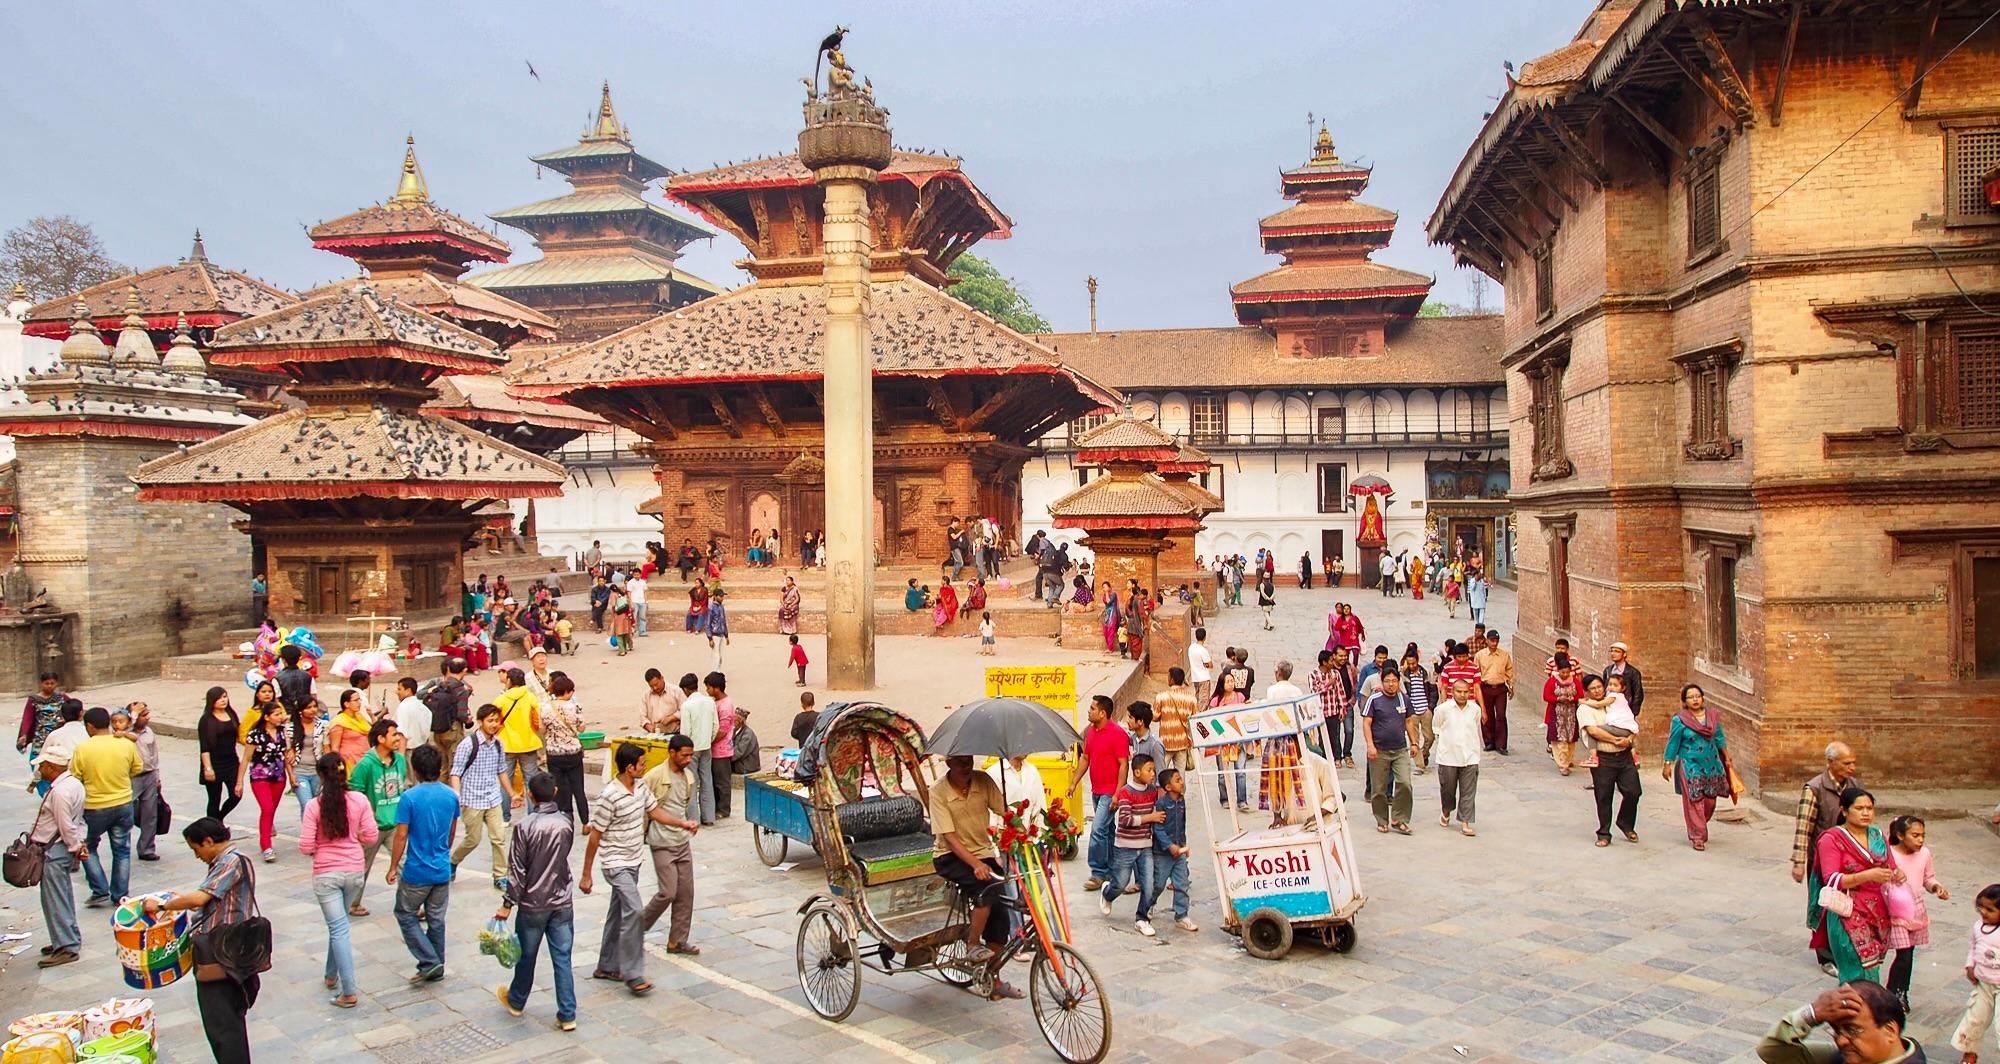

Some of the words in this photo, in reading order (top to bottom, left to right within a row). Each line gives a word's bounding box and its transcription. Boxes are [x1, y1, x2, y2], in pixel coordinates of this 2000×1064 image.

[989, 671, 1028, 686] स्पेशल
[1030, 667, 1067, 688] कुल्फी
[1243, 849, 1311, 877] Koshi
[1253, 876, 1310, 890] ICE-CREAM
